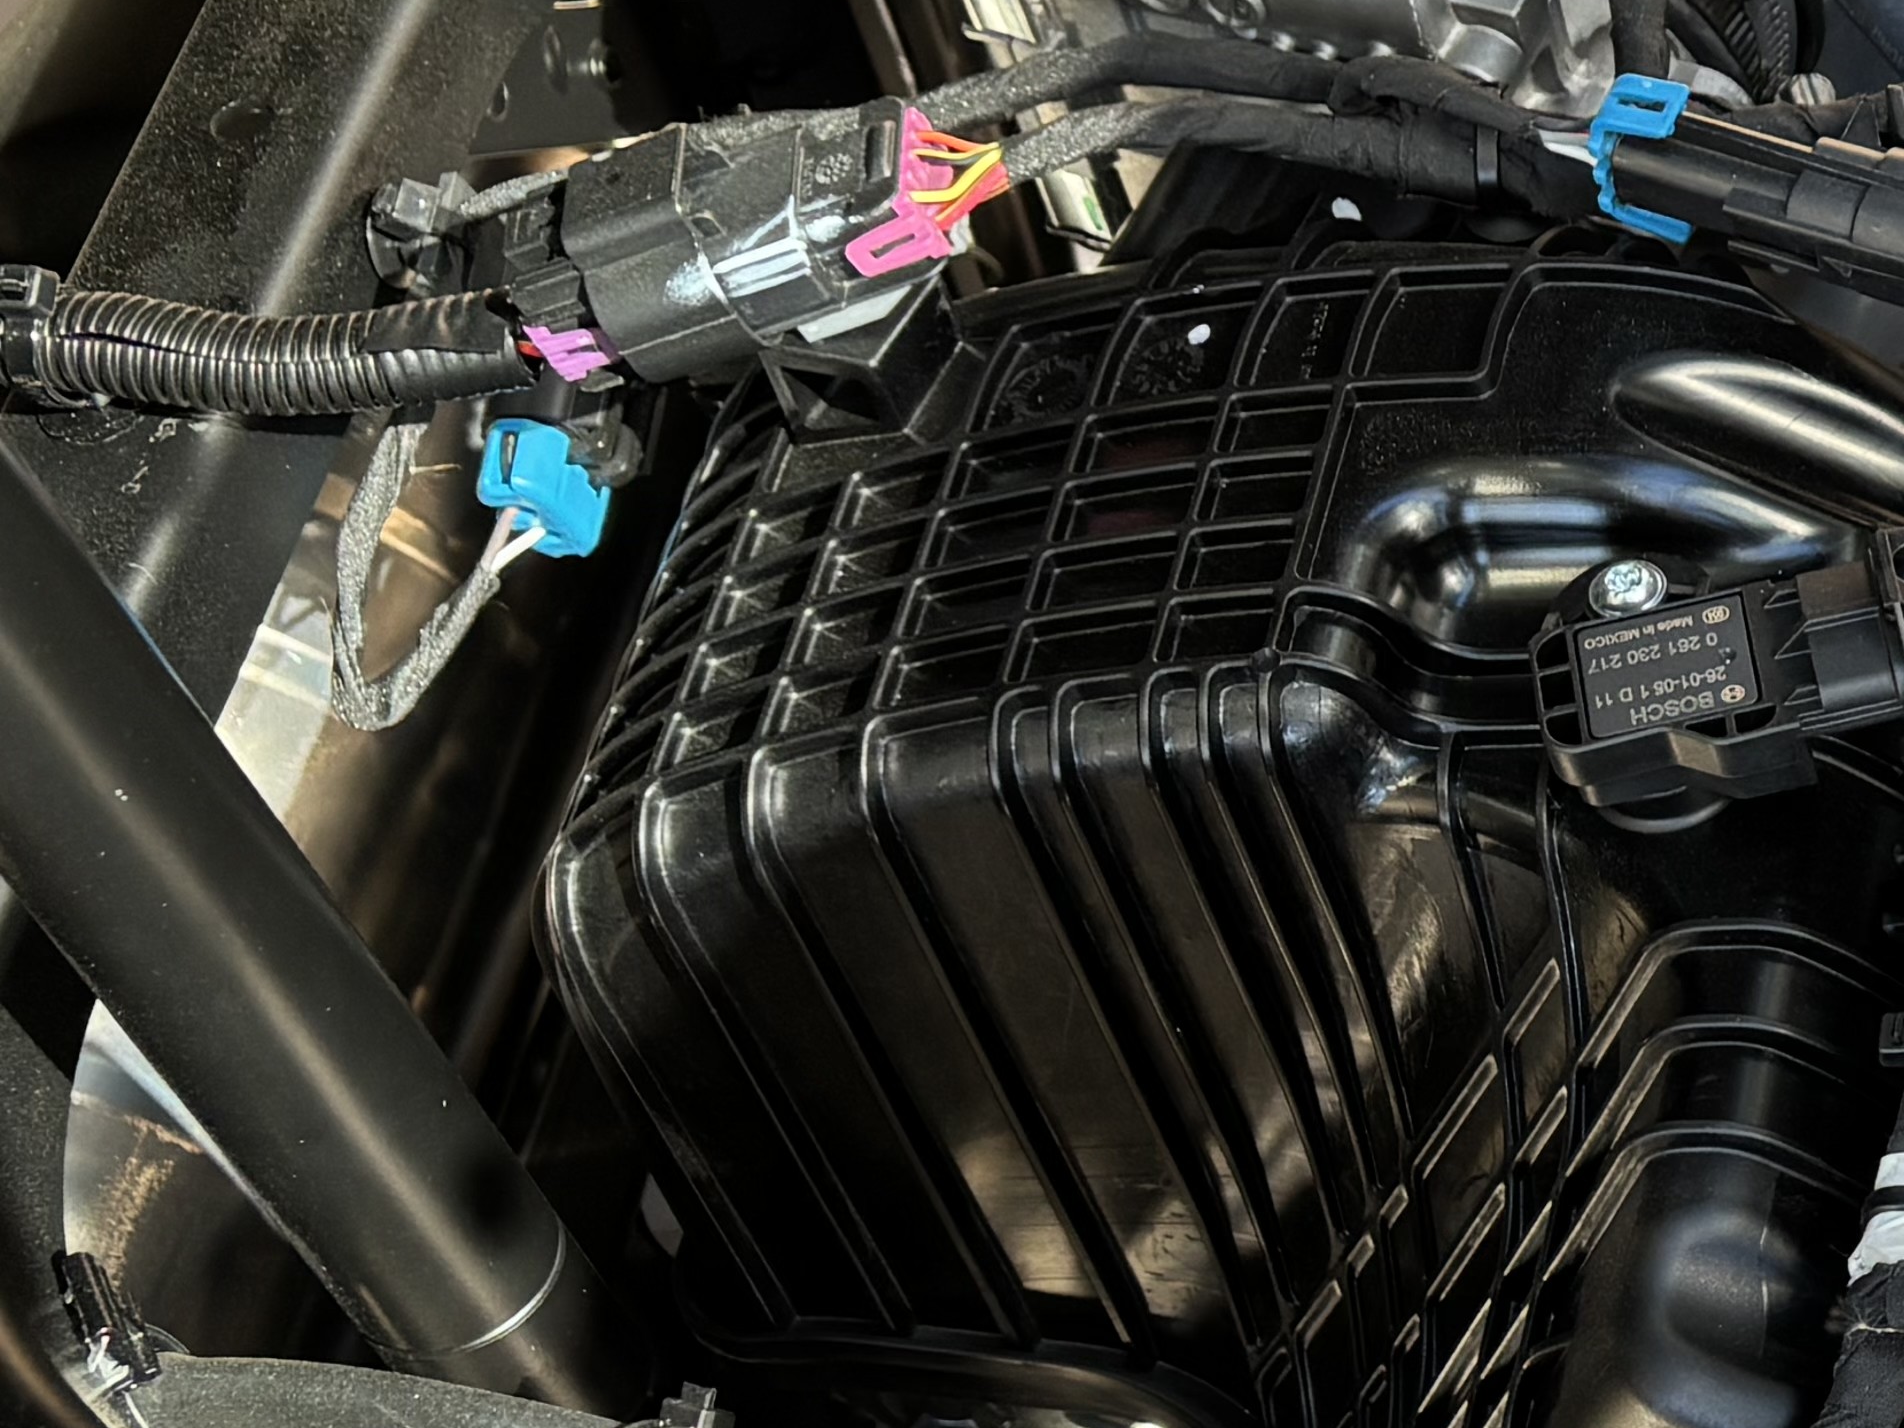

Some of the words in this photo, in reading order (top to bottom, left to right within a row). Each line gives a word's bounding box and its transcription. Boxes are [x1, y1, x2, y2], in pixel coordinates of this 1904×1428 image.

[1657, 615, 1694, 631] Made
[1584, 628, 1640, 650] MEXICO
[1669, 635, 1701, 656] 261
[1706, 632, 1718, 646] 0
[1588, 653, 1622, 675] 217
[1627, 644, 1661, 665] 230
[1595, 693, 1613, 709] 11
[1620, 687, 1633, 703] D
[1630, 690, 1715, 725] BOSCH
